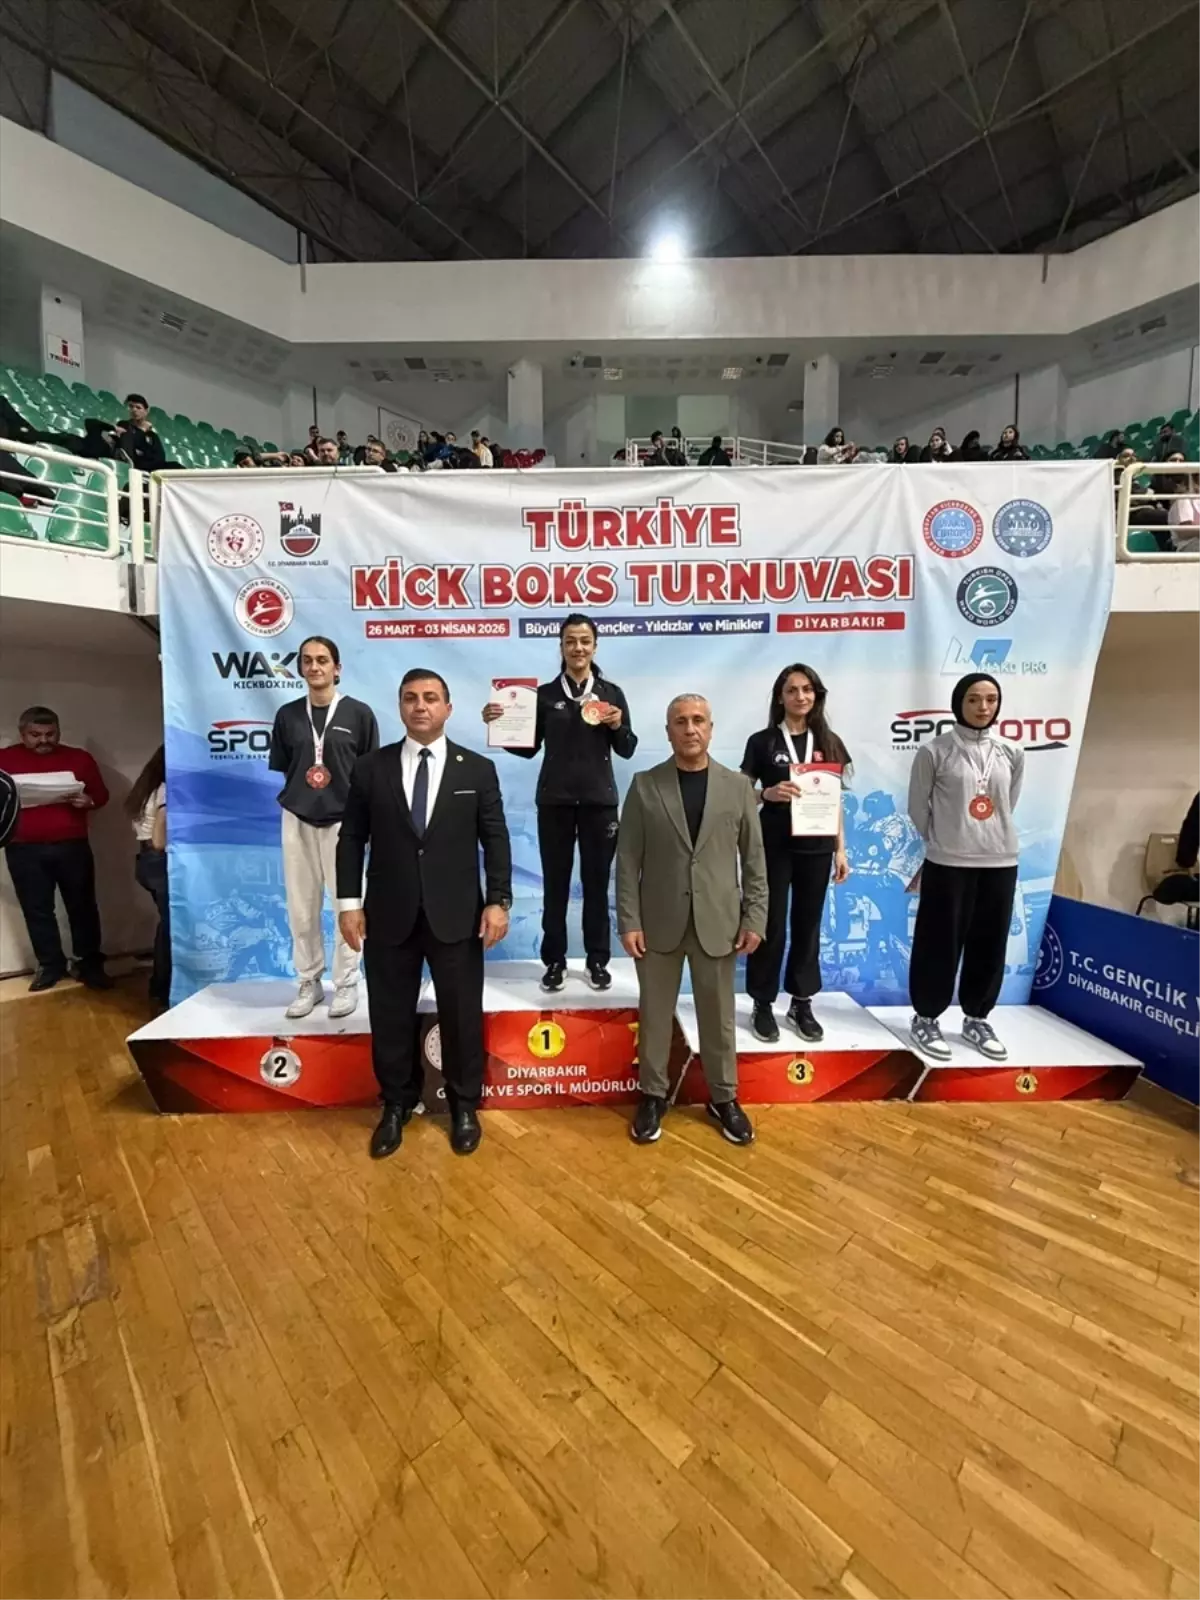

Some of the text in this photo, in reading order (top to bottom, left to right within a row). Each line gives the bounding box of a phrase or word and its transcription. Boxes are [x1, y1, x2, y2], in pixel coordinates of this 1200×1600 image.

[522, 498, 741, 551] TÜRKİYE
[351, 555, 915, 611] KİCK BOKS TURNUVASI
[368, 625, 382, 635] 26
[384, 624, 416, 635] MART
[424, 624, 439, 634] 03
[441, 621, 476, 634] NİSAN
[477, 623, 506, 634] 2026
[598, 621, 635, 634] ençler
[645, 620, 694, 631] Yıldızlar
[698, 621, 713, 631] ve
[715, 619, 764, 631] Minikler
[794, 616, 885, 628] DİYARBAKIR
[212, 651, 302, 679] WAK
[233, 680, 304, 689] KICKBOXING
[995, 718, 1071, 742] OTO
[1069, 950, 1099, 975] T.C.
[1102, 964, 1188, 1010] GENÇLİK
[1068, 972, 1200, 1038] DİYARBAKIR GENÇLİ
[541, 1029, 550, 1050] 1
[274, 1056, 288, 1078] 2
[507, 1064, 587, 1079] DİYARBAKIR
[796, 1064, 805, 1081] 3
[496, 1084, 514, 1097] VE
[516, 1083, 552, 1096] SPOR
[555, 1080, 567, 1094] İL
[1022, 1077, 1031, 1091] 4
